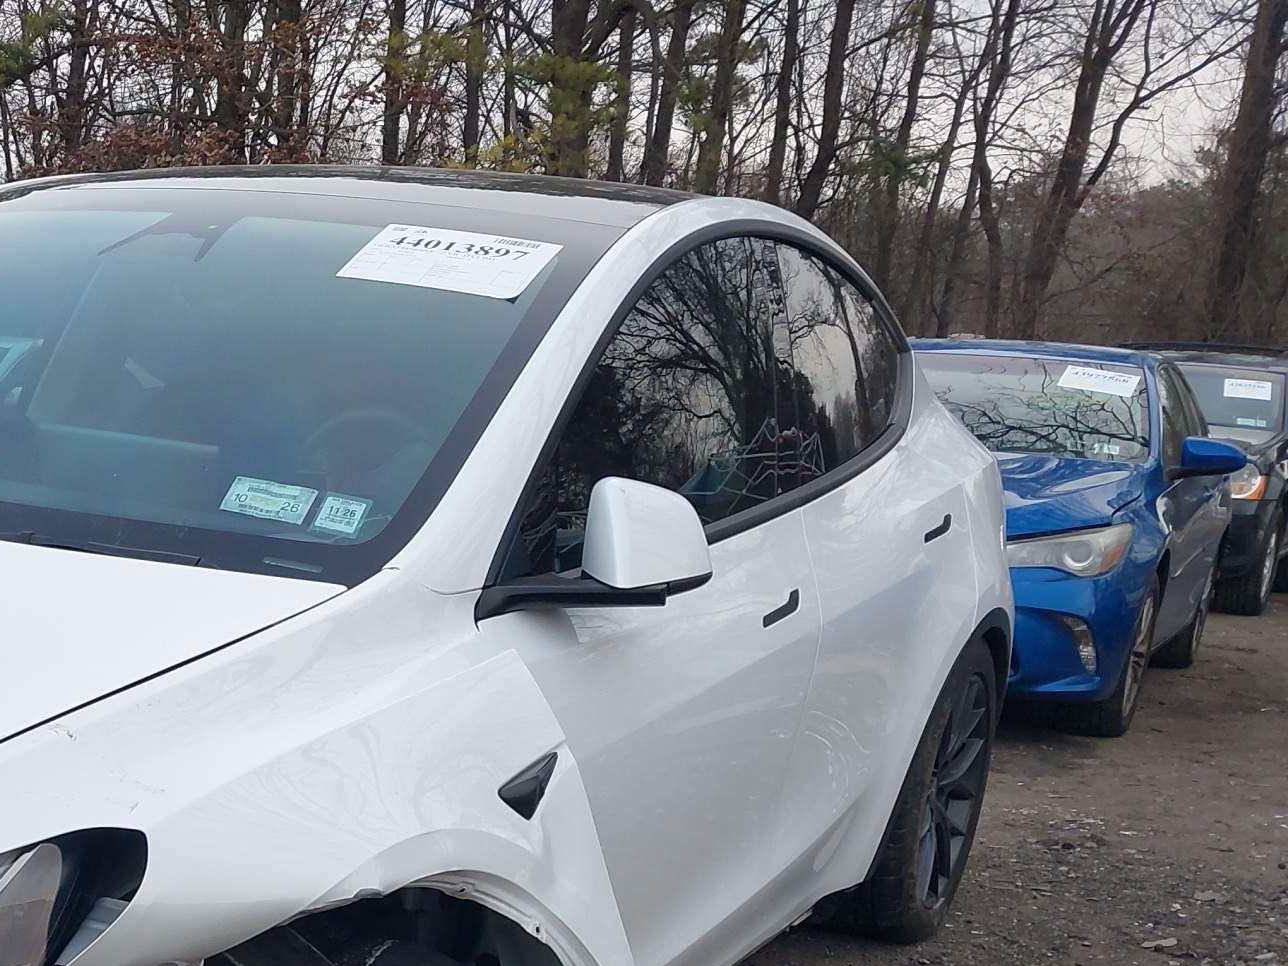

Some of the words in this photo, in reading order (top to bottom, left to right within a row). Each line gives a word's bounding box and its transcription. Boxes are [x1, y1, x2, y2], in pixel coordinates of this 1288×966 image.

[389, 236, 530, 261] 44013897
[233, 493, 248, 503] 10
[280, 502, 300, 513] 26
